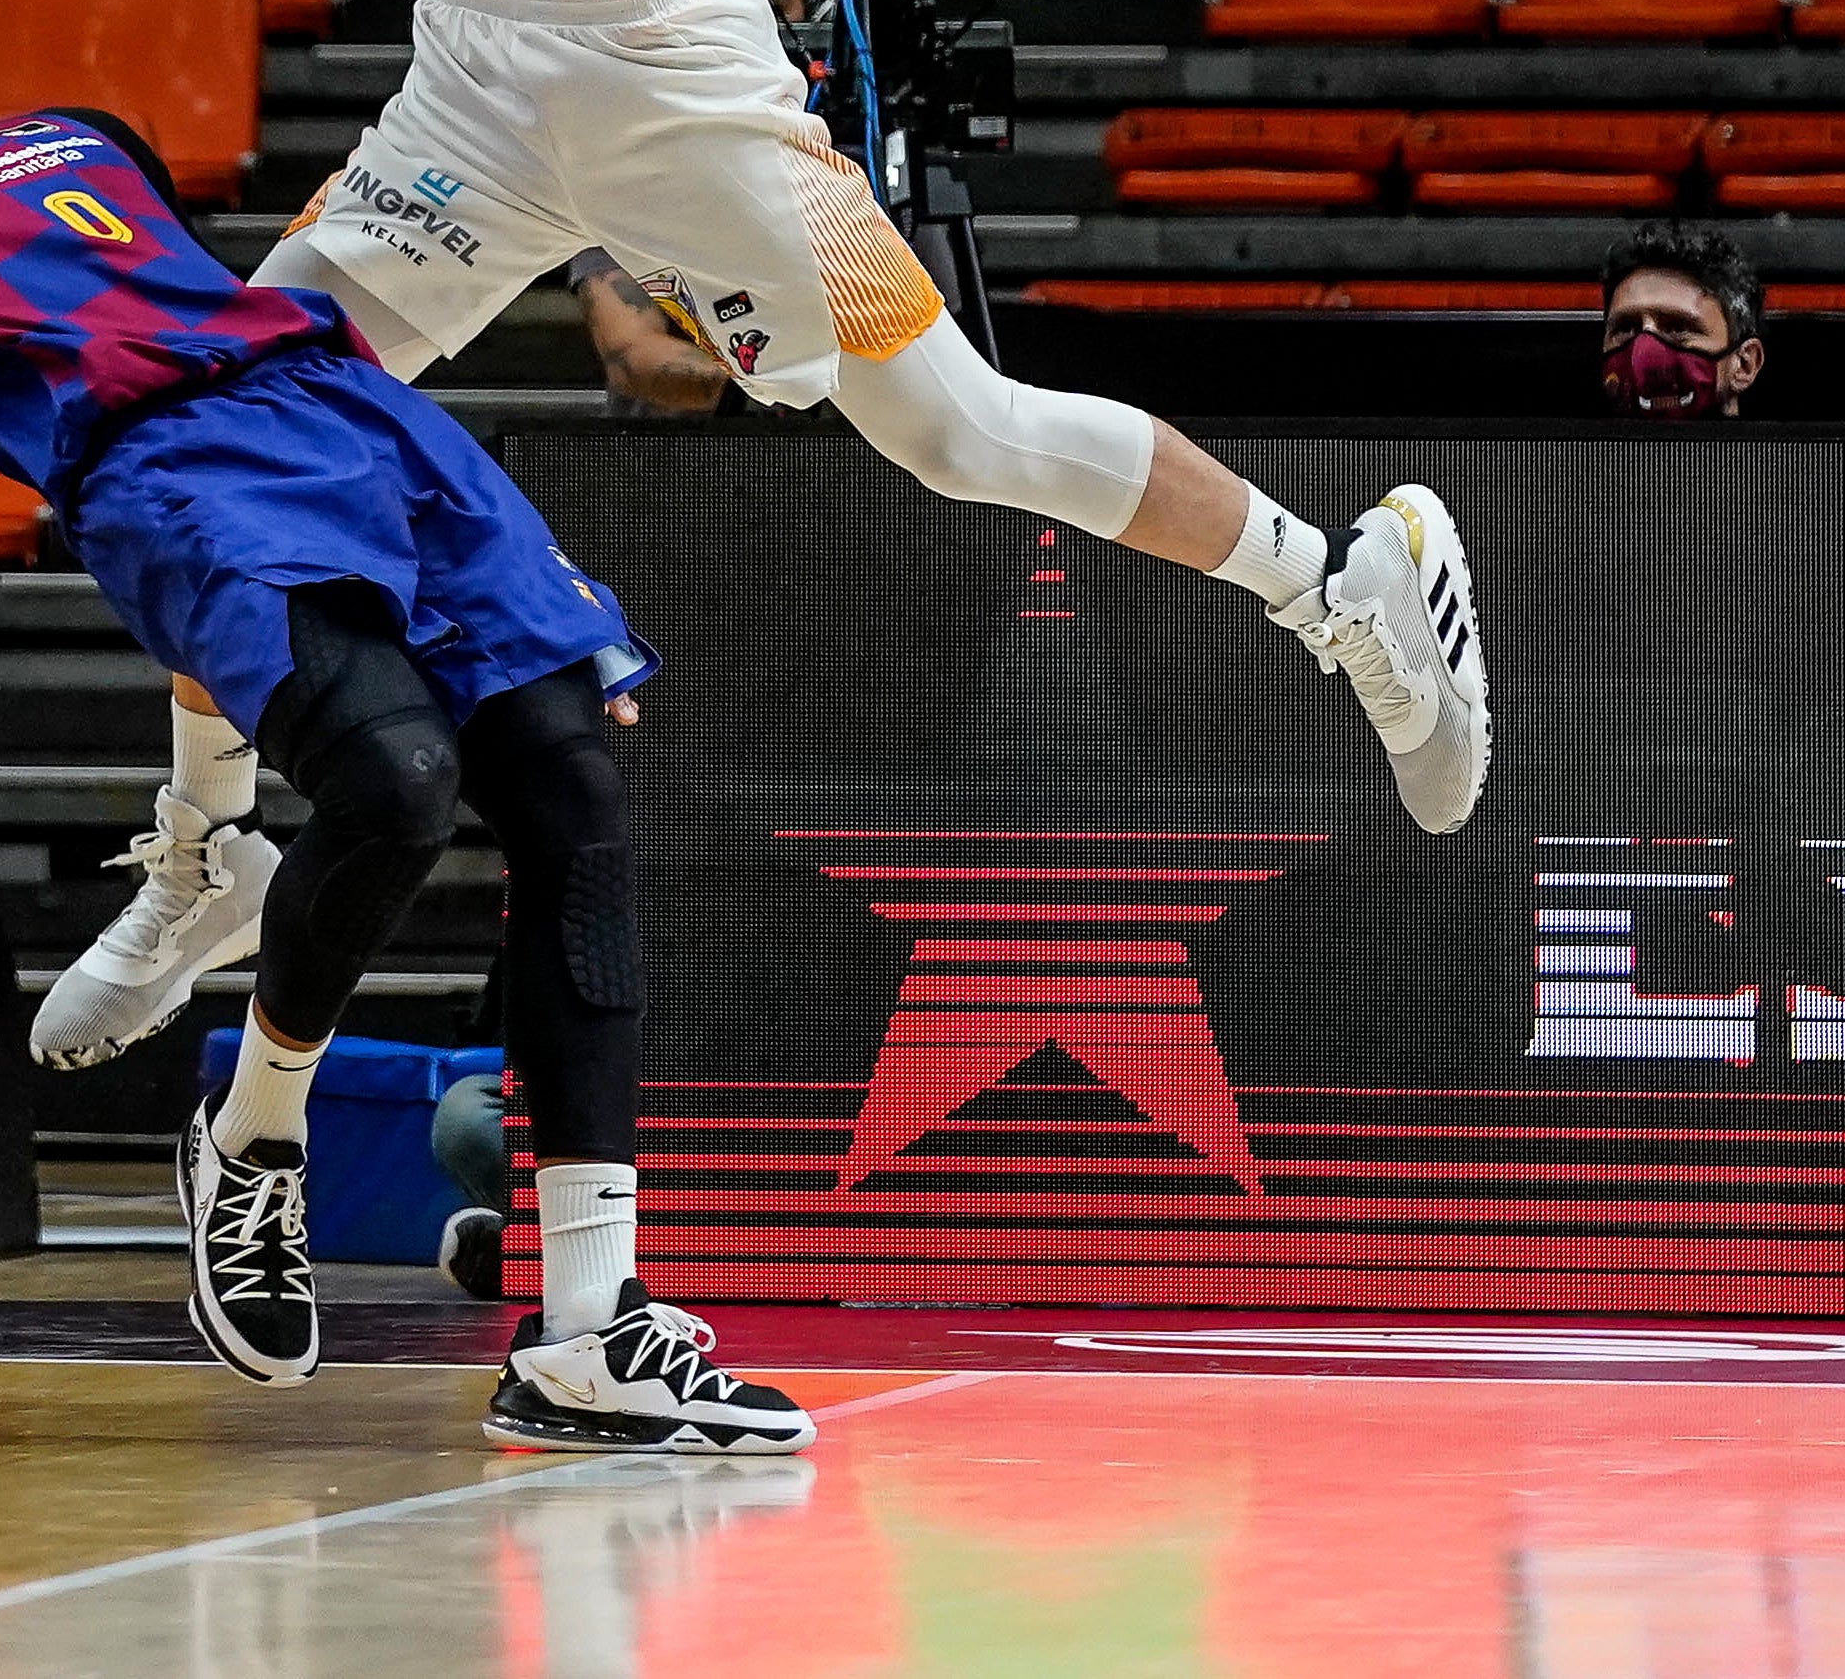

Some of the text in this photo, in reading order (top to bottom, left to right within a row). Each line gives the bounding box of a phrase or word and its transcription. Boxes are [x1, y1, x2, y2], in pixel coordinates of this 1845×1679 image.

[43, 190, 133, 244] 0
[361, 220, 428, 266] KELME
[720, 301, 746, 320] acb
